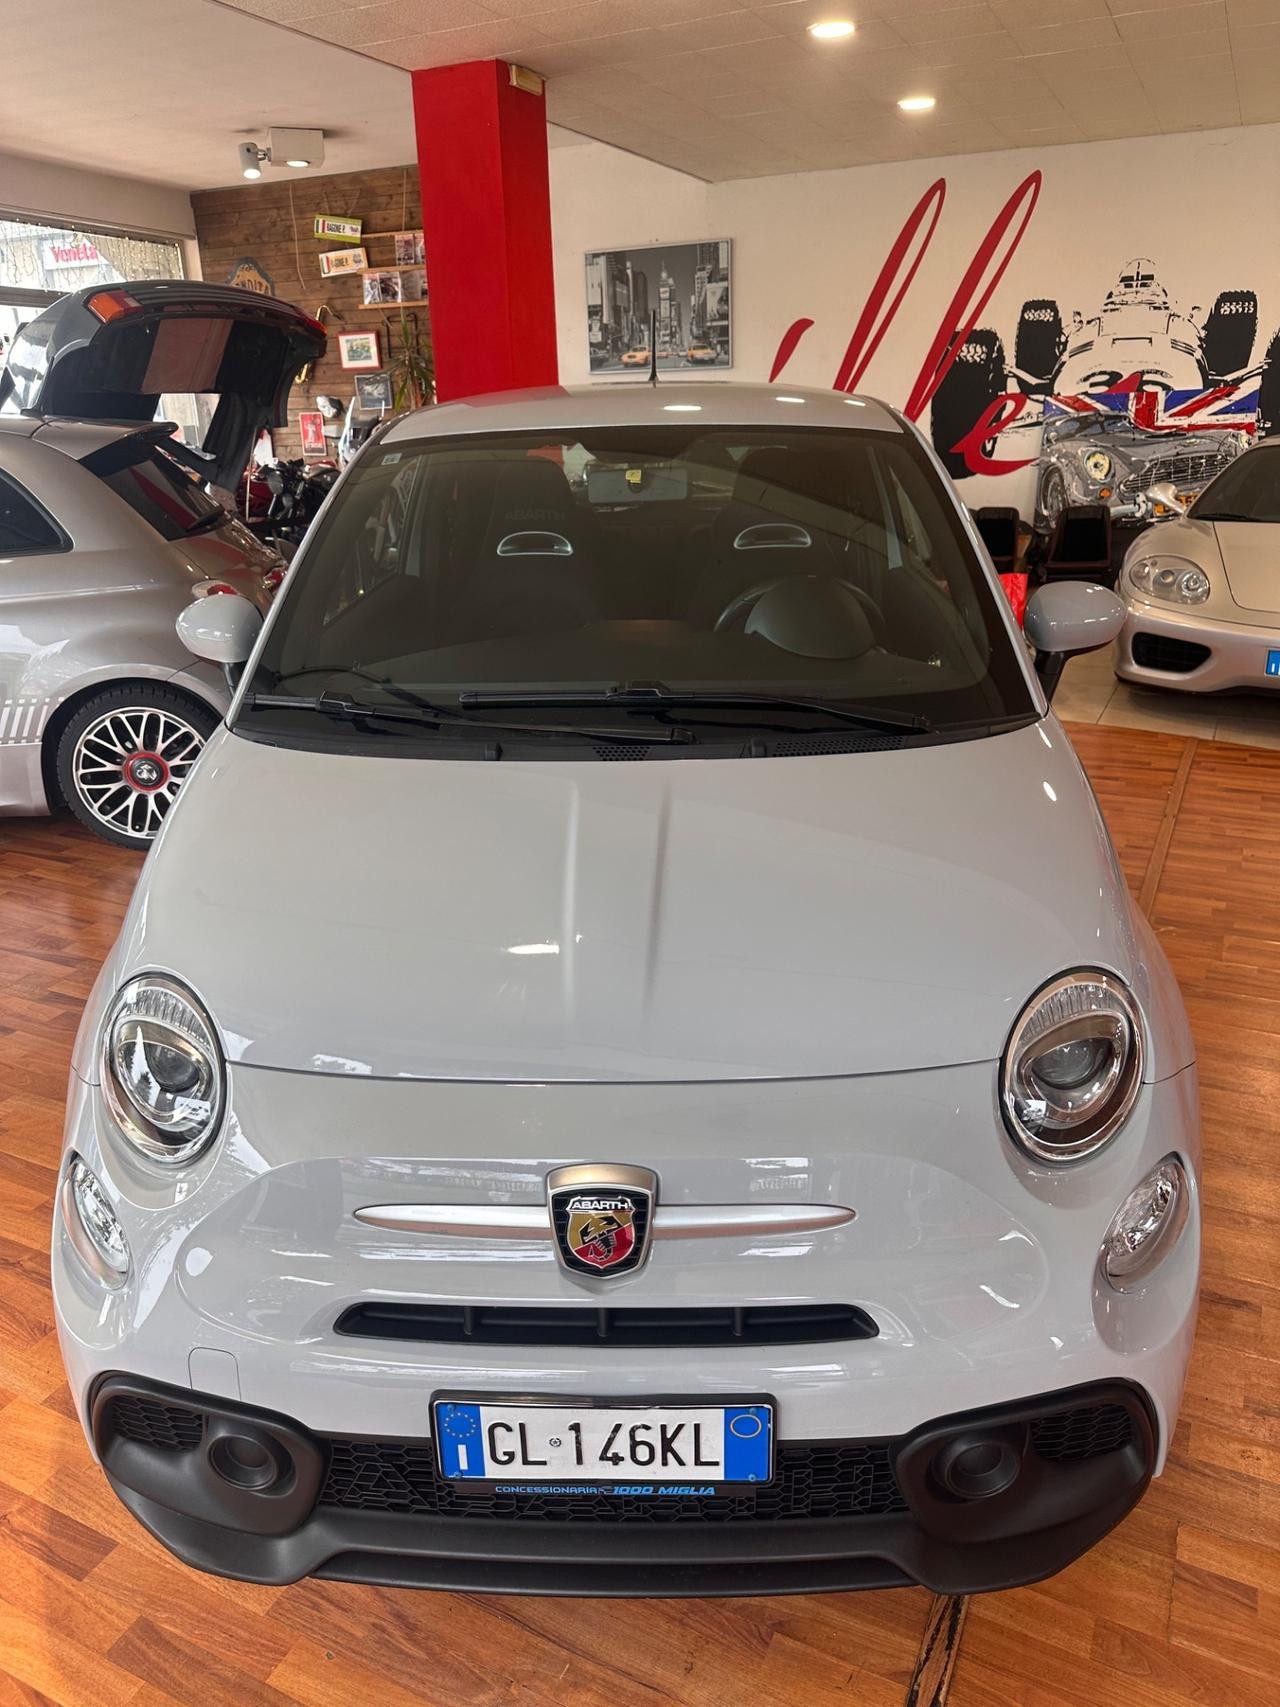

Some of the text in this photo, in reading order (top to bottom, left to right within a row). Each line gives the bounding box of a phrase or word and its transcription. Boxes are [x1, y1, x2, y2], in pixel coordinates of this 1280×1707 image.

[50, 242, 98, 263] Veneta
[572, 1200, 628, 1210] ABARTH
[487, 1421, 548, 1466] GL
[567, 1421, 720, 1467] 146KL
[495, 1485, 716, 1496] CONCESSIONARIA 1000 MIGLIA
